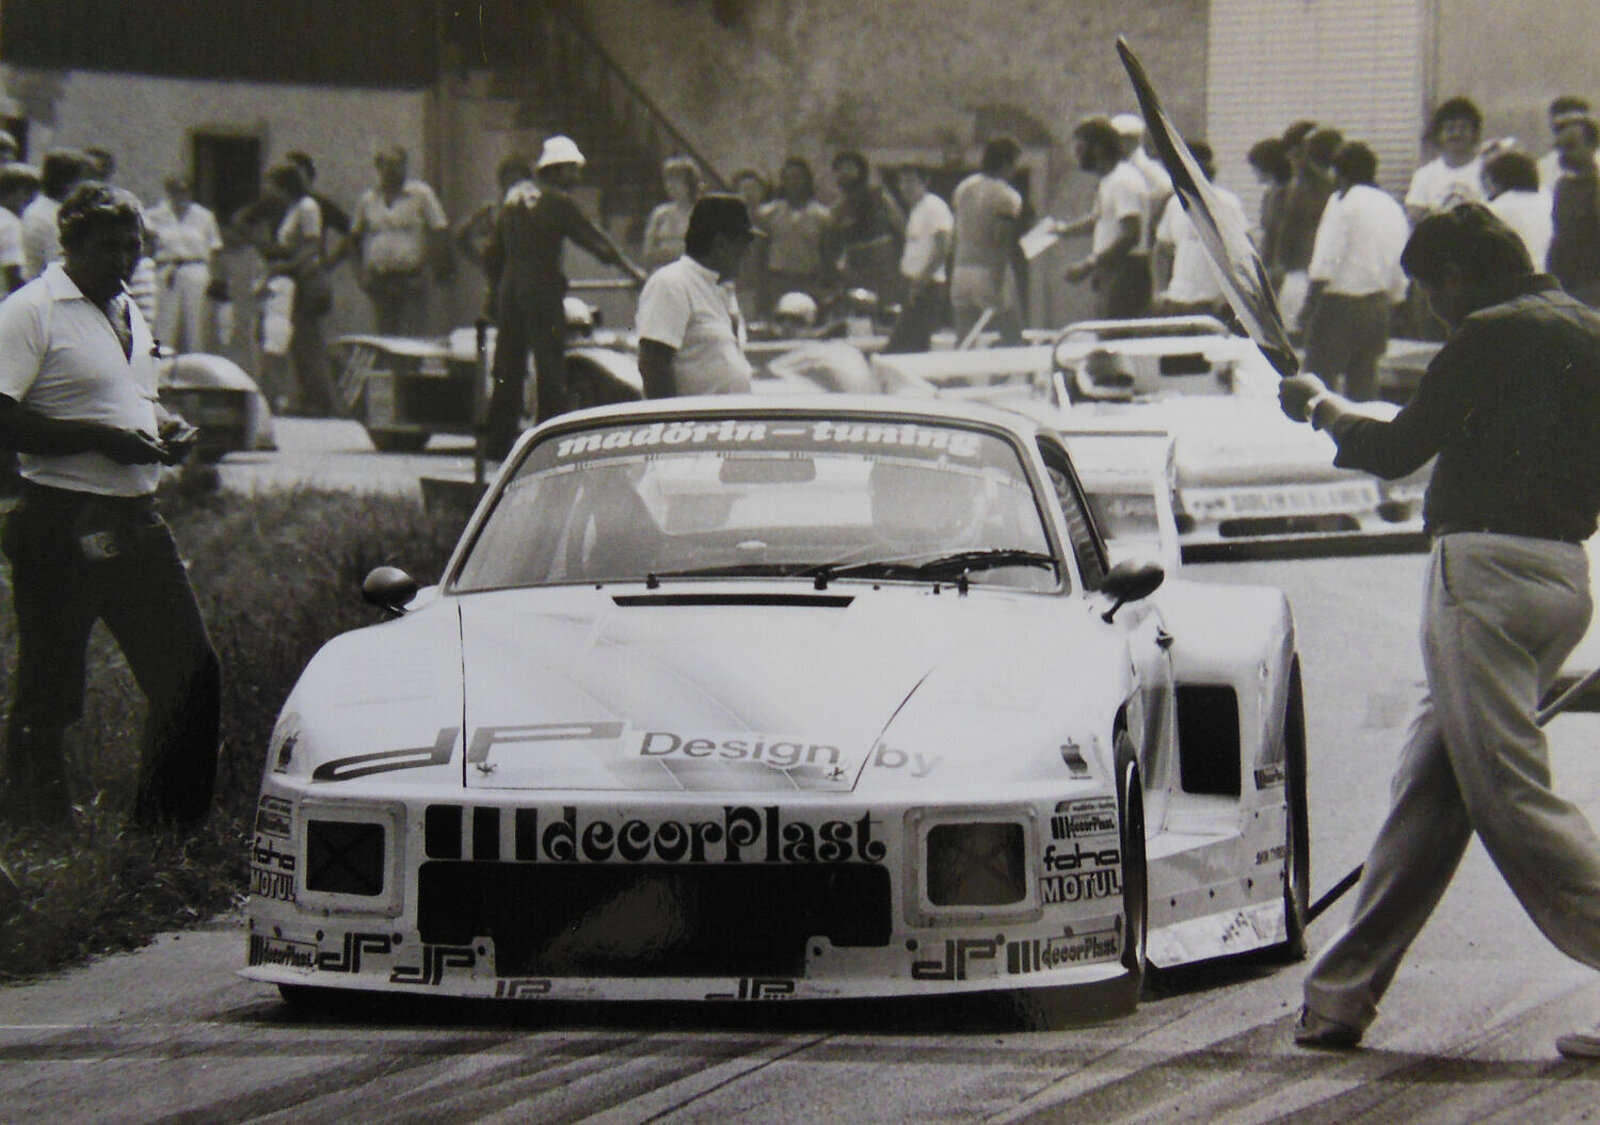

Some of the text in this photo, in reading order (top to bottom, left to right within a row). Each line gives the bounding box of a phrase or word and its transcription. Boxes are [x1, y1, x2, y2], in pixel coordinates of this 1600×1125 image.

[639, 731, 839, 768] Design
[874, 738, 942, 779] by
[250, 867, 297, 904] MOTUL
[1038, 869, 1122, 905] MOTUL
